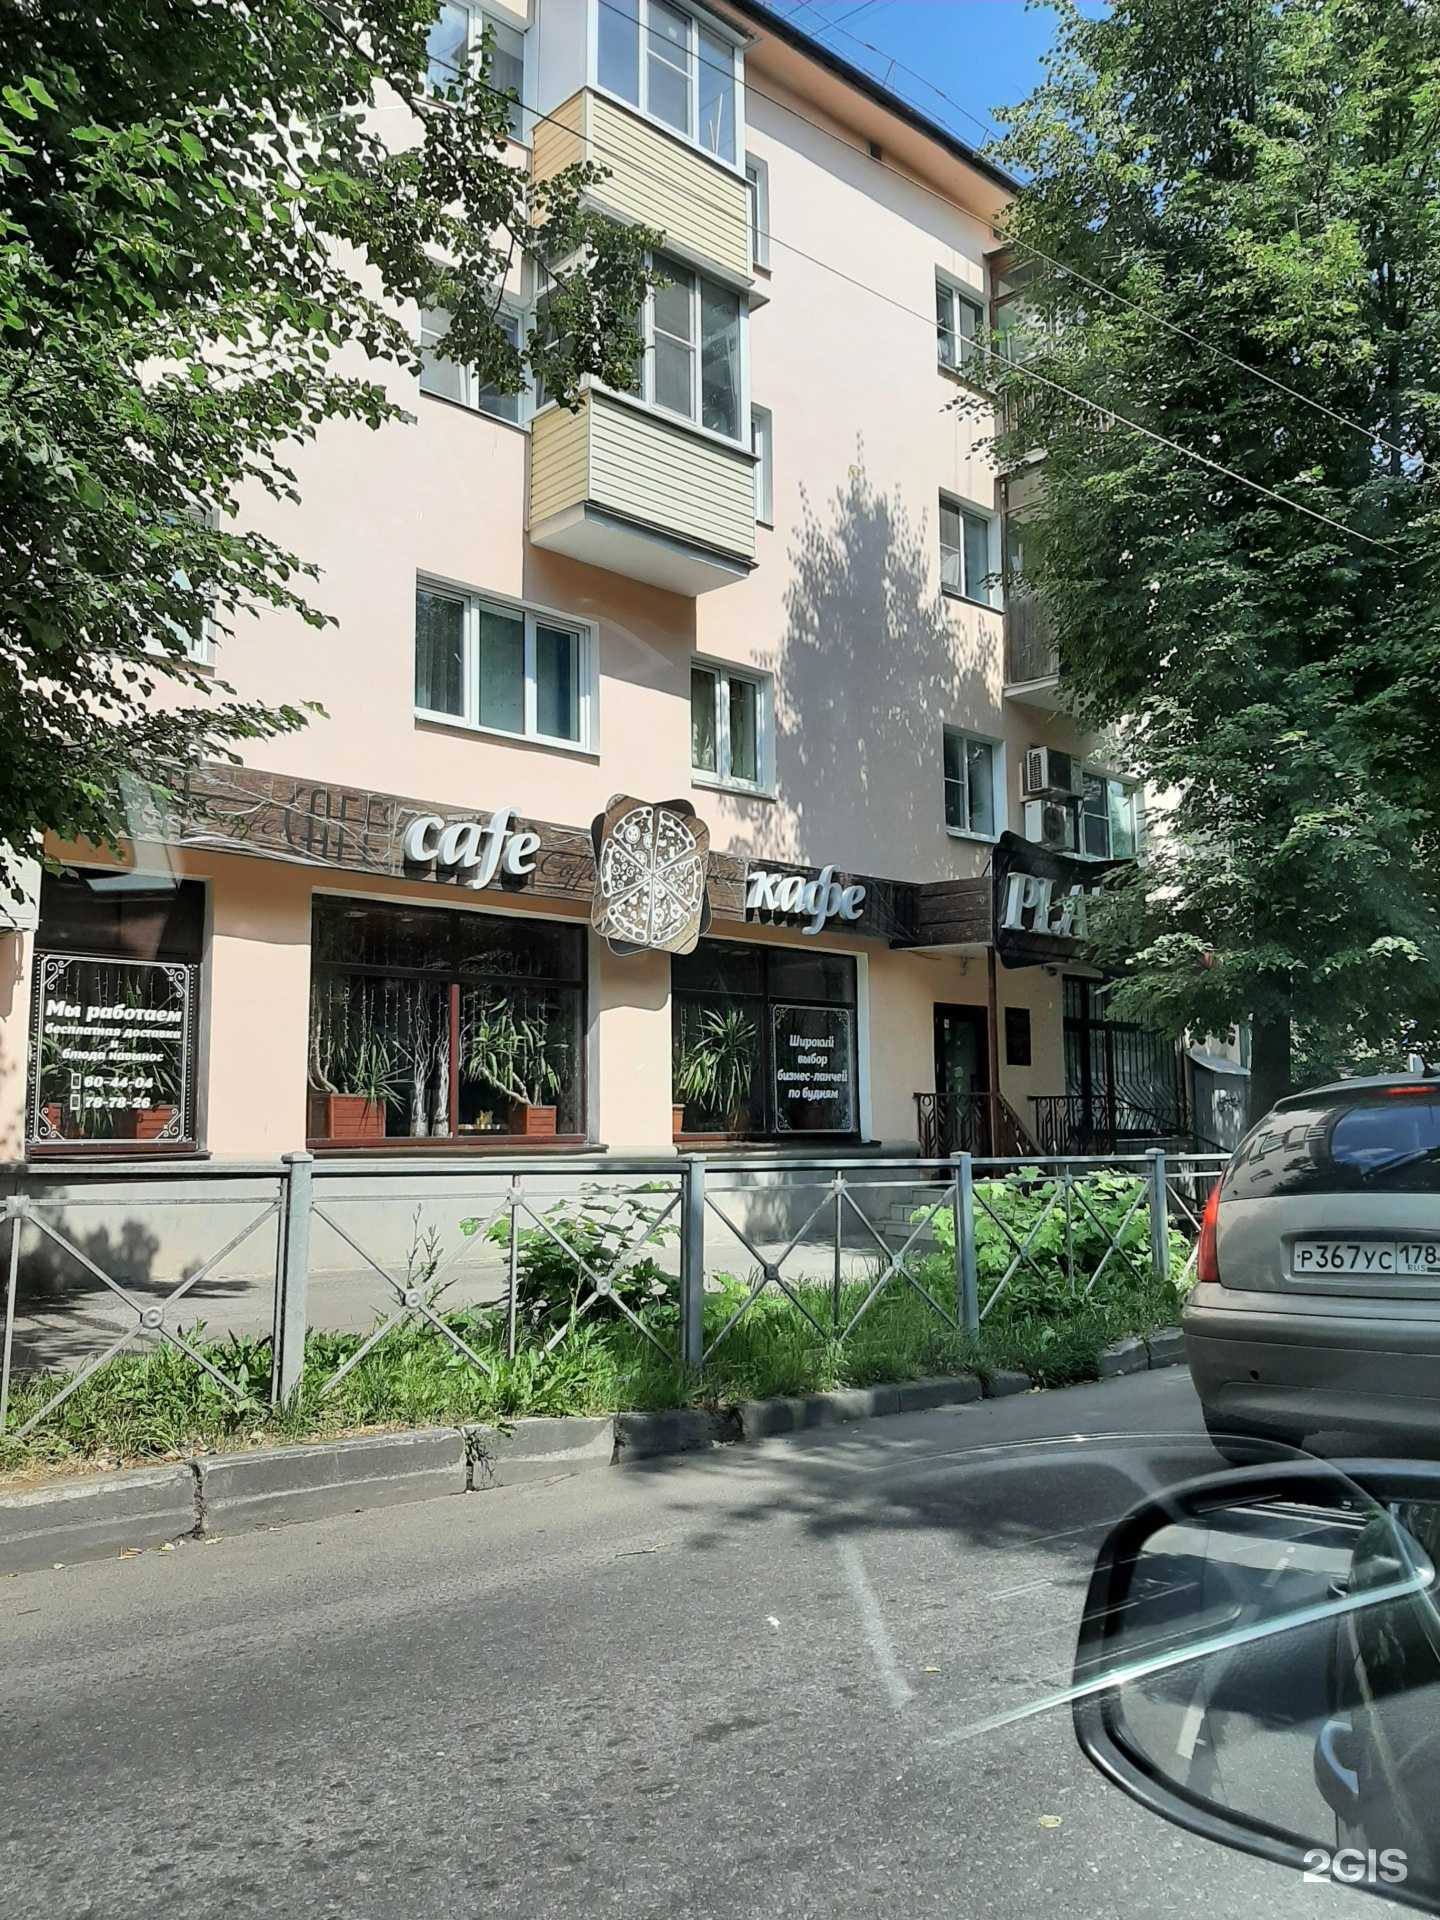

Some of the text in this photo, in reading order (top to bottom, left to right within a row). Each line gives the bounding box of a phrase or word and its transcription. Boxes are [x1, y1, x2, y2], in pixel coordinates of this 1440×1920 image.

[404, 806, 541, 890] cafe
[746, 864, 866, 935] кафе
[1001, 872, 1104, 941] PLA
[45, 999, 182, 1022] Мы работаем
[45, 1022, 182, 1039] бесплатная доставка
[789, 1034, 835, 1050] Широкий
[62, 1047, 164, 1062] блюда навынос
[797, 1052, 828, 1067] выбор
[84, 1076, 153, 1089] 60-44-04
[777, 1068, 848, 1082] бизнес-ланчей
[788, 1086, 839, 1101] по будням
[85, 1096, 151, 1109] 78-78-26
[1399, 1245, 1437, 1264] 178
[1407, 1264, 1426, 1272] RUS
